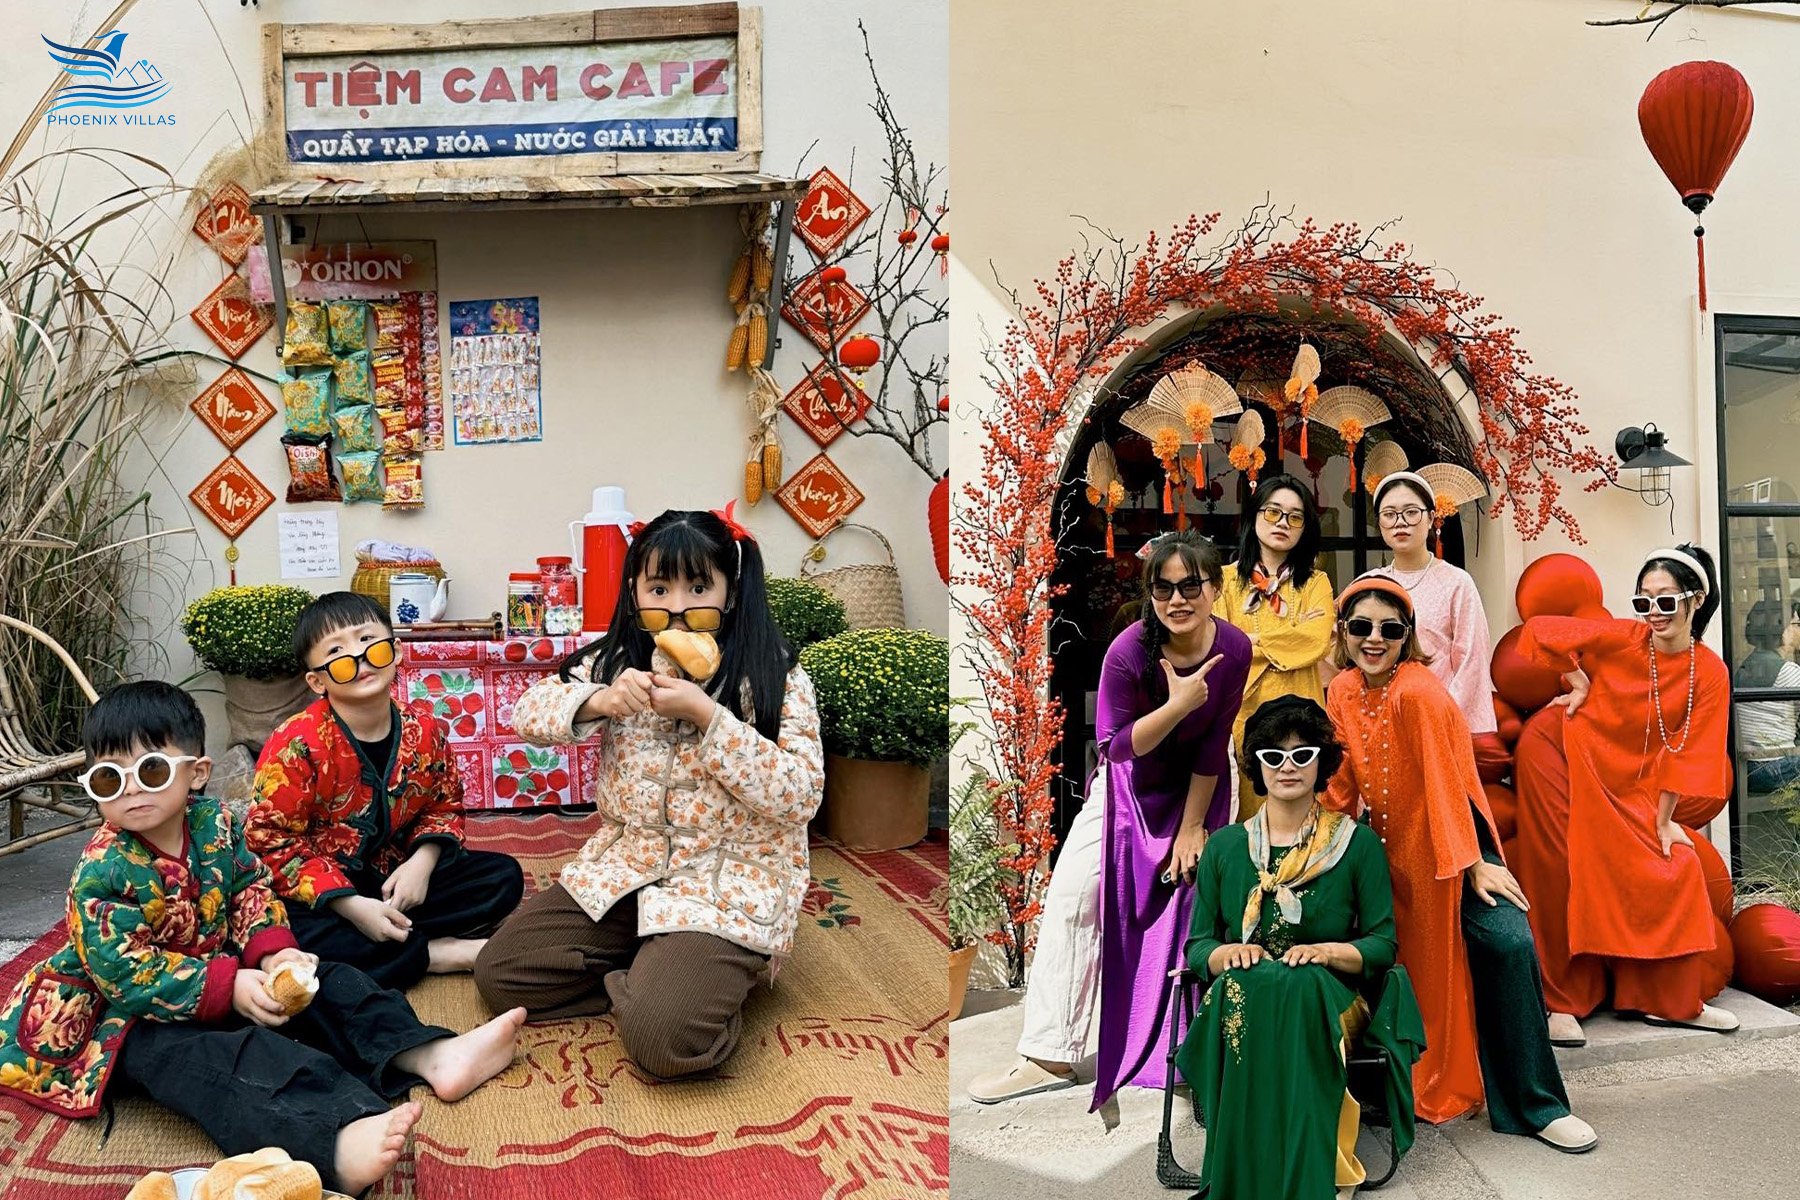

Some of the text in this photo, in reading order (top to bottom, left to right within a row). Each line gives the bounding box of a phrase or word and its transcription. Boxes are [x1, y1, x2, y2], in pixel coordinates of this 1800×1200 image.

[294, 60, 421, 119] TIỆM
[443, 66, 558, 104] CAM
[380, 134, 430, 160] TẠP
[514, 127, 587, 152] NƯỚC
[593, 122, 648, 148] GIẢI
[654, 122, 724, 147] KHÁT
[310, 259, 402, 283] ORION
